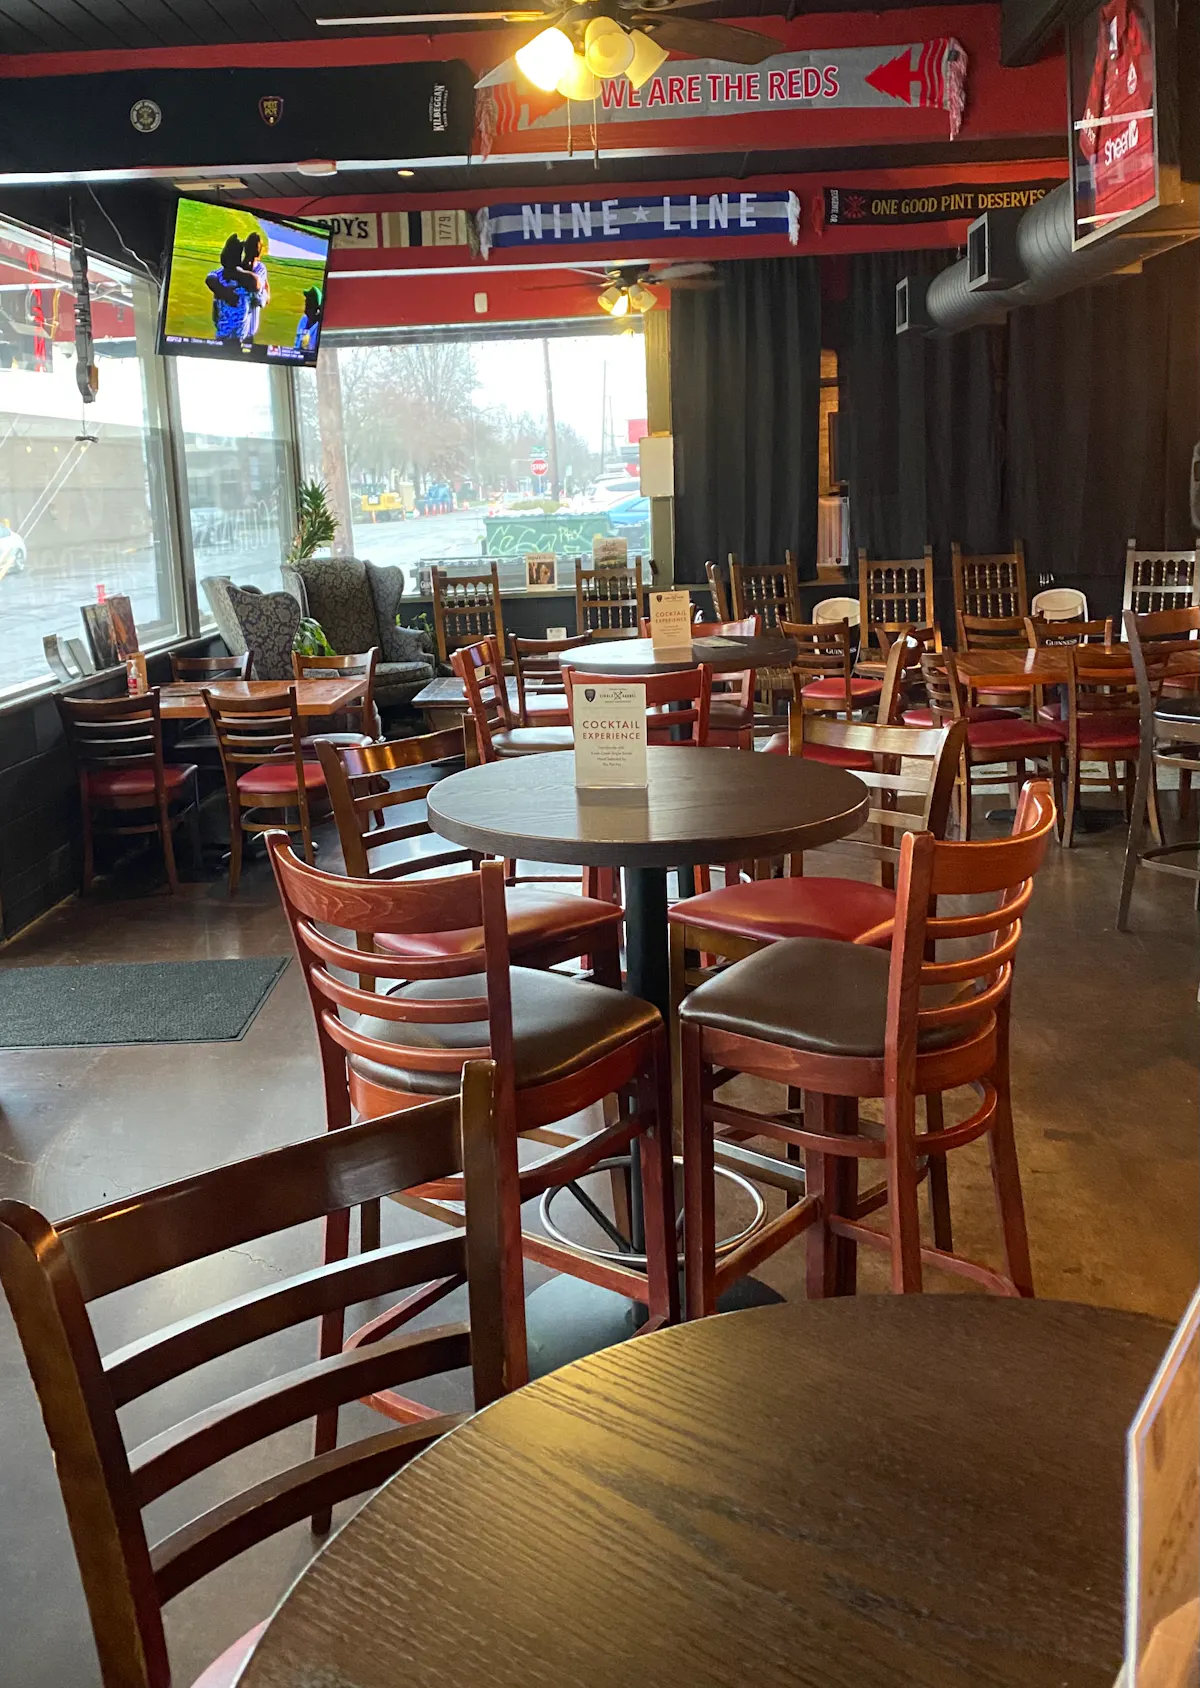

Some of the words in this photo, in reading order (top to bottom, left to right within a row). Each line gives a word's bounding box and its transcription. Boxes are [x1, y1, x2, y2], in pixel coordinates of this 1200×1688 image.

[600, 78, 643, 109] WE
[647, 74, 702, 107] ARE
[706, 72, 760, 103] THE
[767, 65, 840, 101] REDS
[433, 85, 445, 131] KILBEGGAN
[871, 199, 898, 215] ONE
[901, 198, 938, 214] GOOD
[941, 193, 974, 211] PINT
[439, 216, 451, 240] 1779
[522, 199, 621, 240] NINE
[663, 193, 758, 231] LINE
[531, 462, 547, 471] STOP
[582, 720, 640, 729] COCKTAIL
[582, 732, 640, 740] EXPERIENCE
